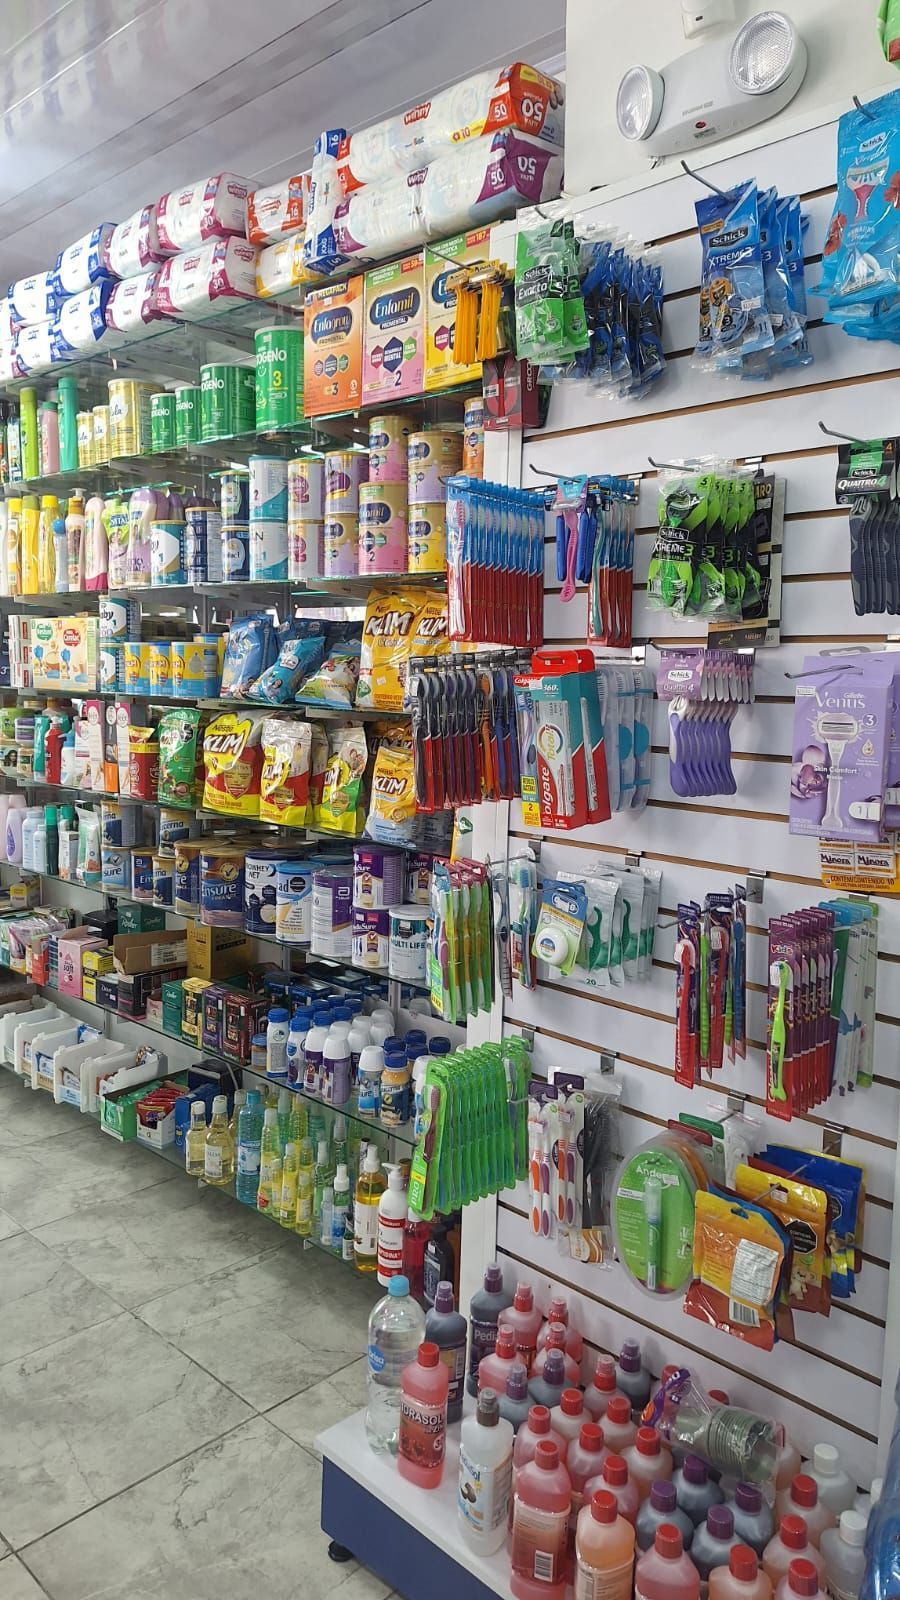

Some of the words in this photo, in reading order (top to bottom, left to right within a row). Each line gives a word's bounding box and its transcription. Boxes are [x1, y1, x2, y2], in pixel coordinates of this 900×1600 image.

[494, 104, 507, 118] 50
[518, 156, 538, 175] 50
[490, 168, 505, 185] 50
[290, 206, 299, 218] 16
[476, 231, 487, 241] 187
[712, 230, 746, 246] Schick
[213, 277, 225, 290] 30
[519, 282, 547, 300] Exacto
[375, 292, 414, 318] Enfamil
[272, 370, 282, 387] 3
[395, 371, 403, 386] 2
[332, 382, 339, 396] 3
[660, 527, 686, 541] Schick
[369, 552, 376, 563] 2
[366, 611, 413, 636] KLIM
[416, 616, 450, 637] KLIM
[670, 670, 690, 679] Schick
[688, 683, 695, 693] 4
[815, 692, 866, 709] Venus
[866, 714, 874, 726] 3
[203, 733, 244, 755] KLIM
[814, 765, 828, 773] Skin
[829, 766, 858, 775] Comfort
[374, 776, 408, 796] KLIM
[528, 802, 534, 811] 2
[820, 853, 852, 866] Minora
[857, 855, 890, 868] Minora
[410, 941, 426, 950] LIFE
[586, 978, 597, 986] 20
